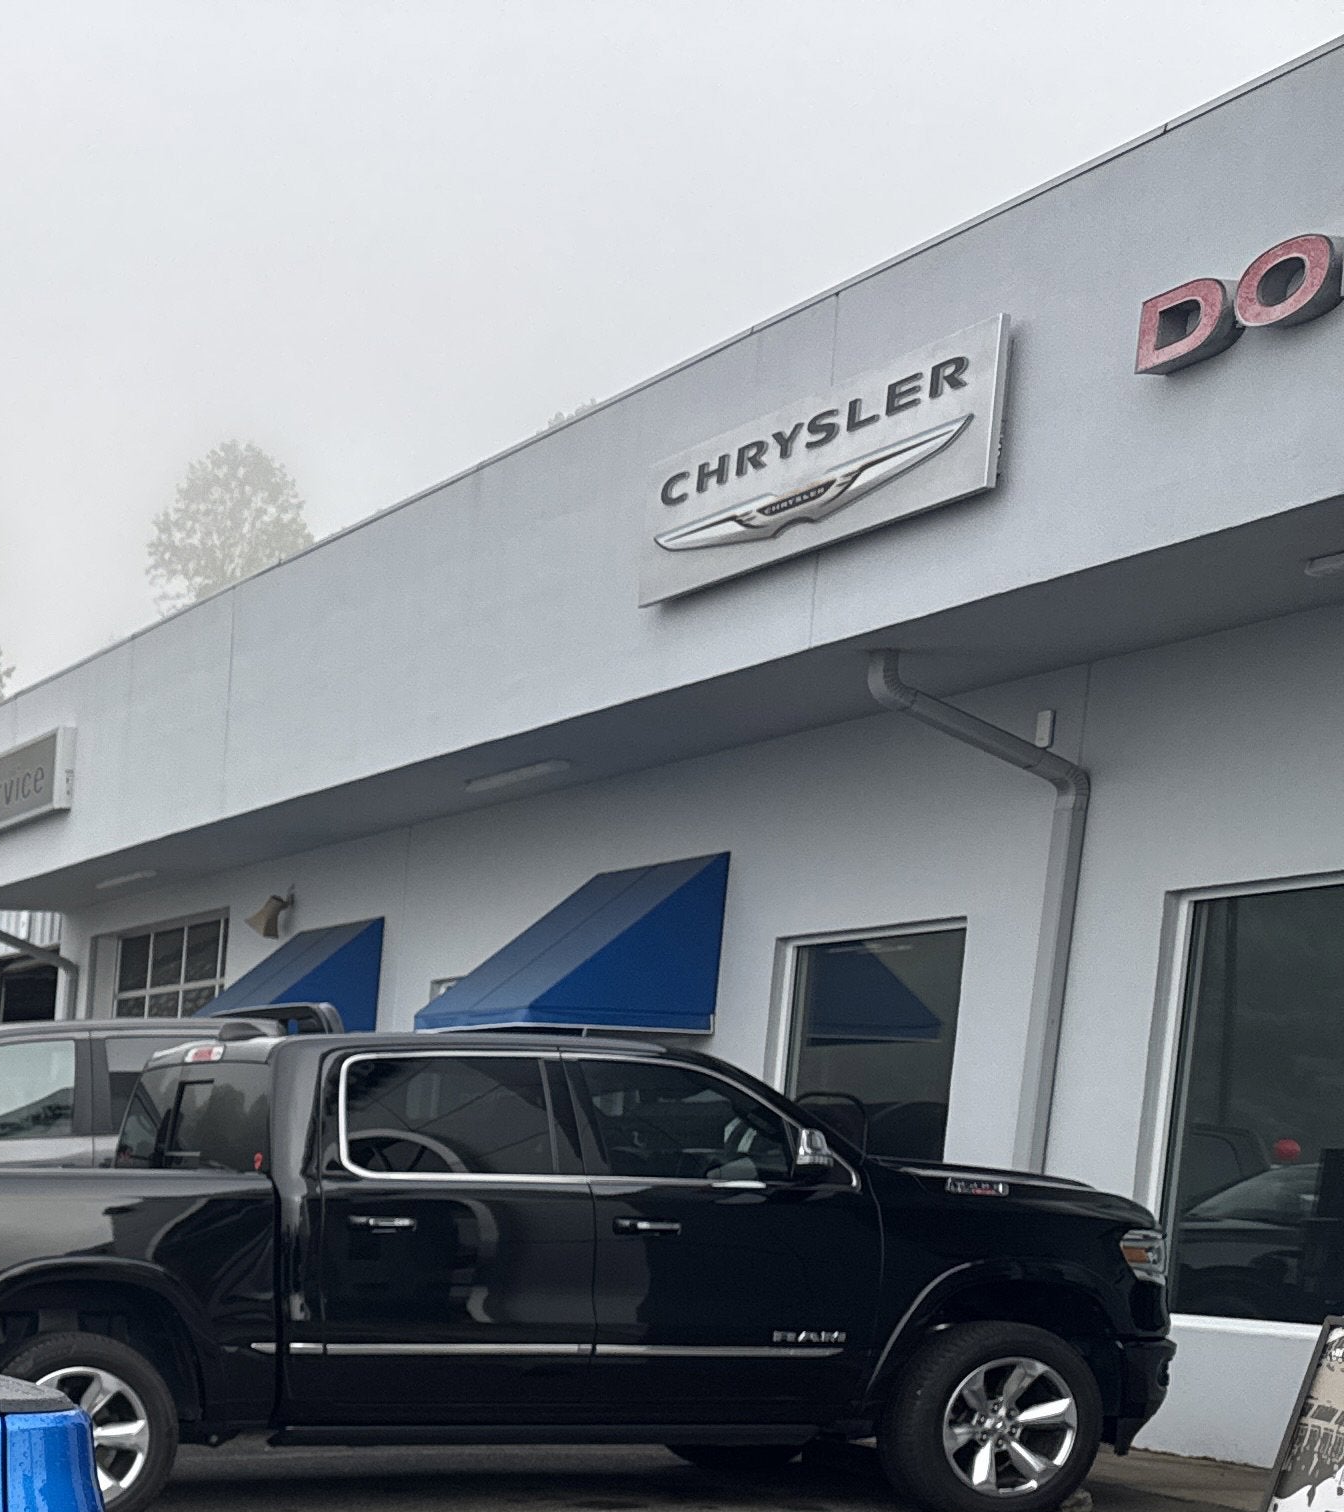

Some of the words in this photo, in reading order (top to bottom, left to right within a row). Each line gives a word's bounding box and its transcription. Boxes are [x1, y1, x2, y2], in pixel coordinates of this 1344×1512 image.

[660, 355, 969, 506] CHRYSLER
[763, 486, 825, 515] CHRYSLER
[773, 1330, 846, 1343] RAM
